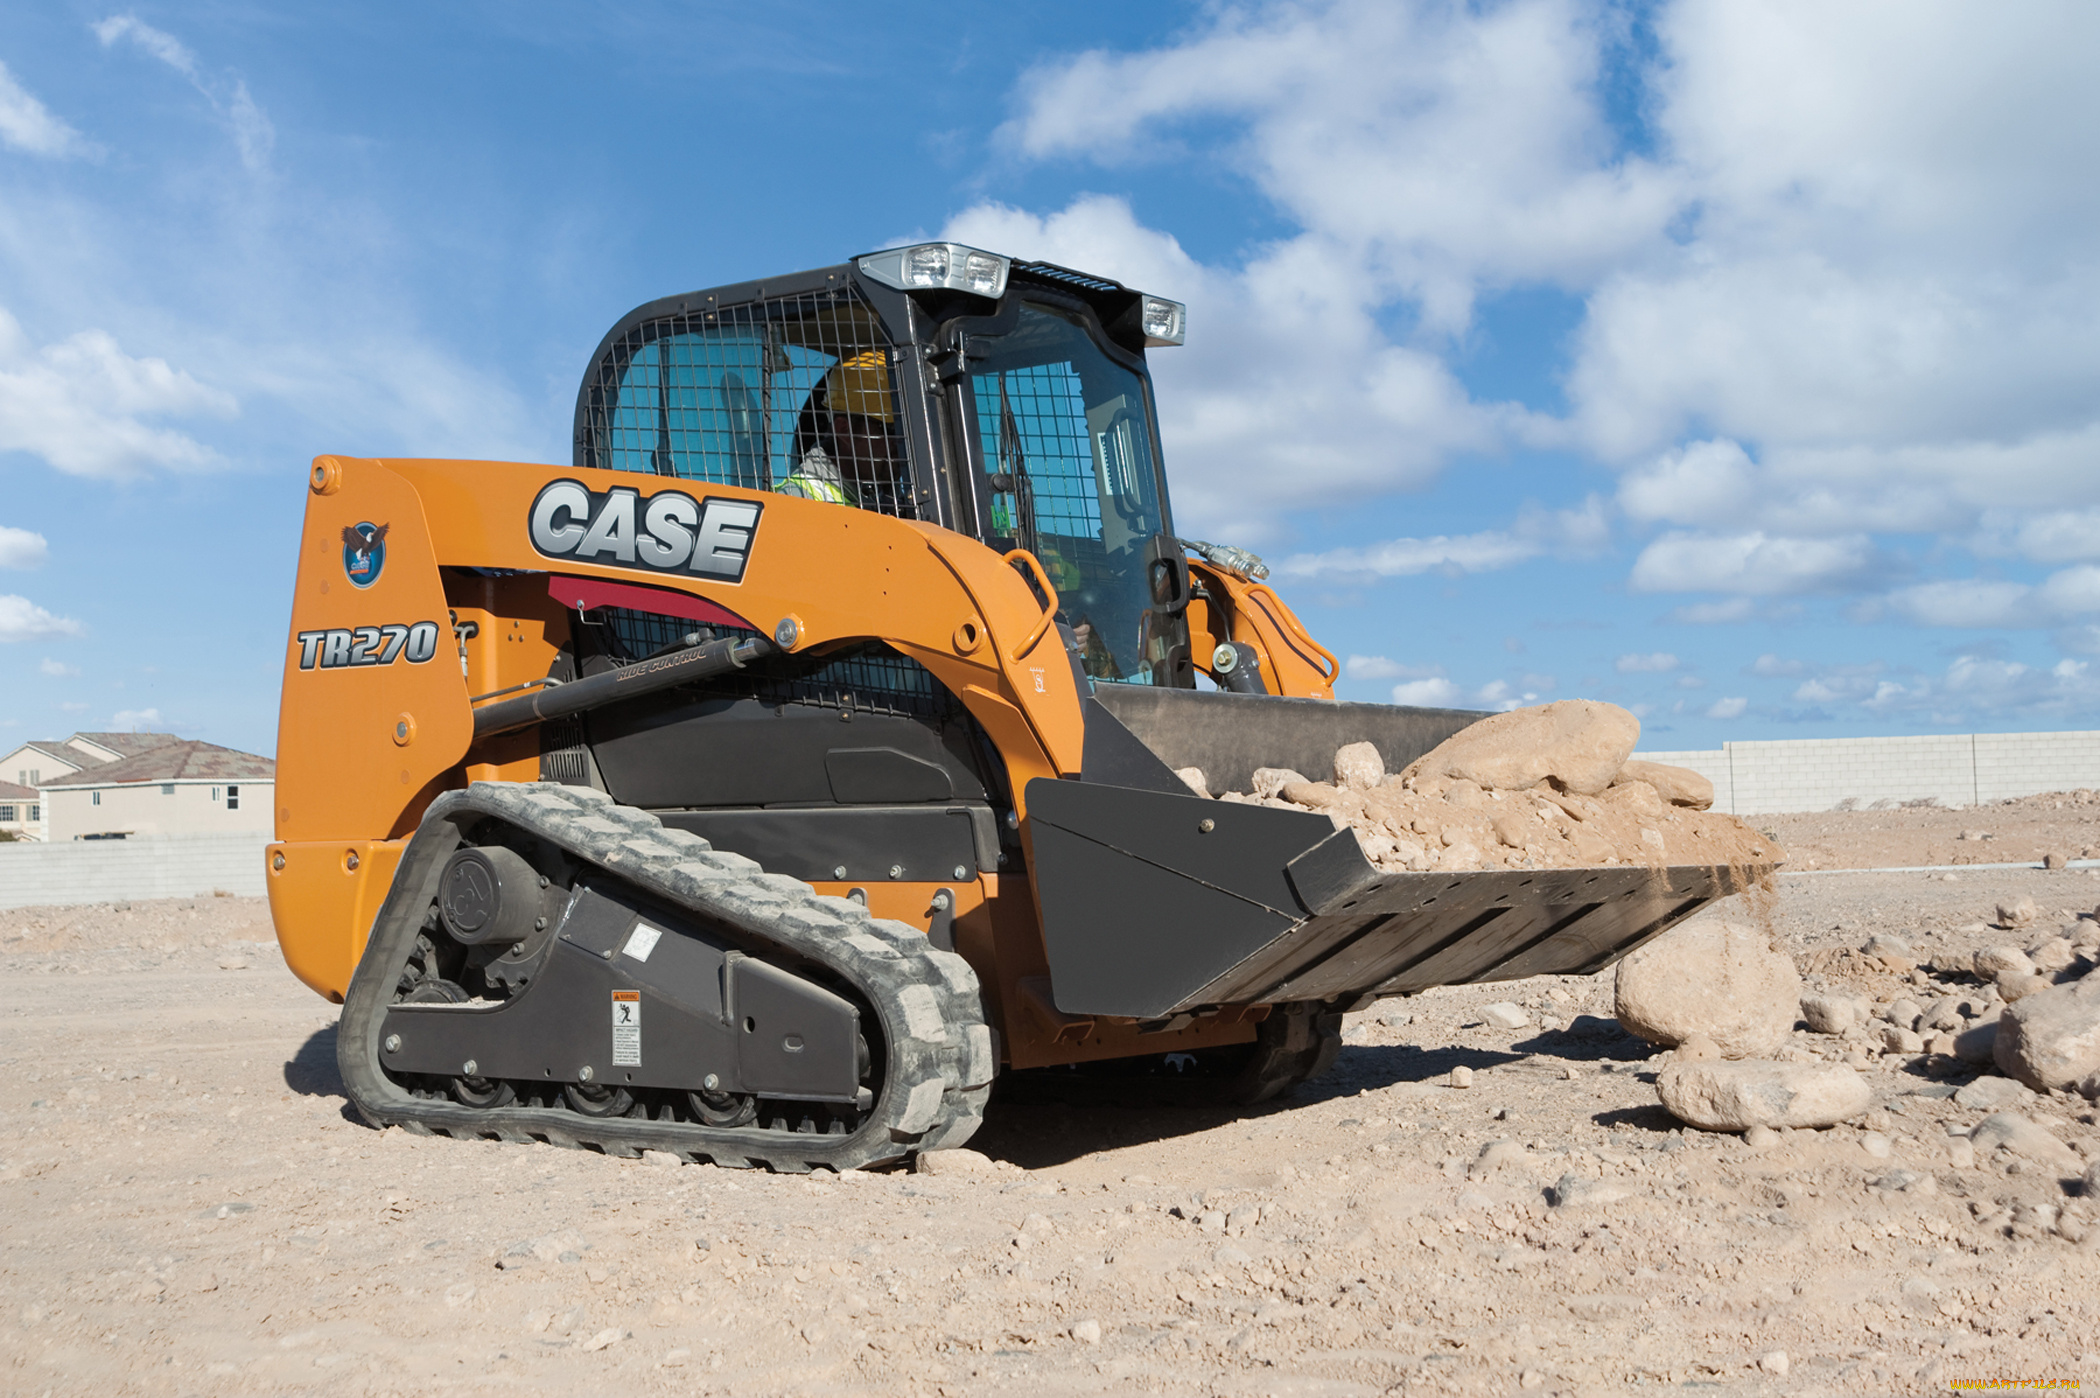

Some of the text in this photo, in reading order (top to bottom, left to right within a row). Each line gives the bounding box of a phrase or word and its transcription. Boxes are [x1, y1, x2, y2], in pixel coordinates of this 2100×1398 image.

[529, 478, 763, 582] CASE
[297, 620, 439, 670] TR270
[616, 649, 707, 682] RIDE CONTROL
